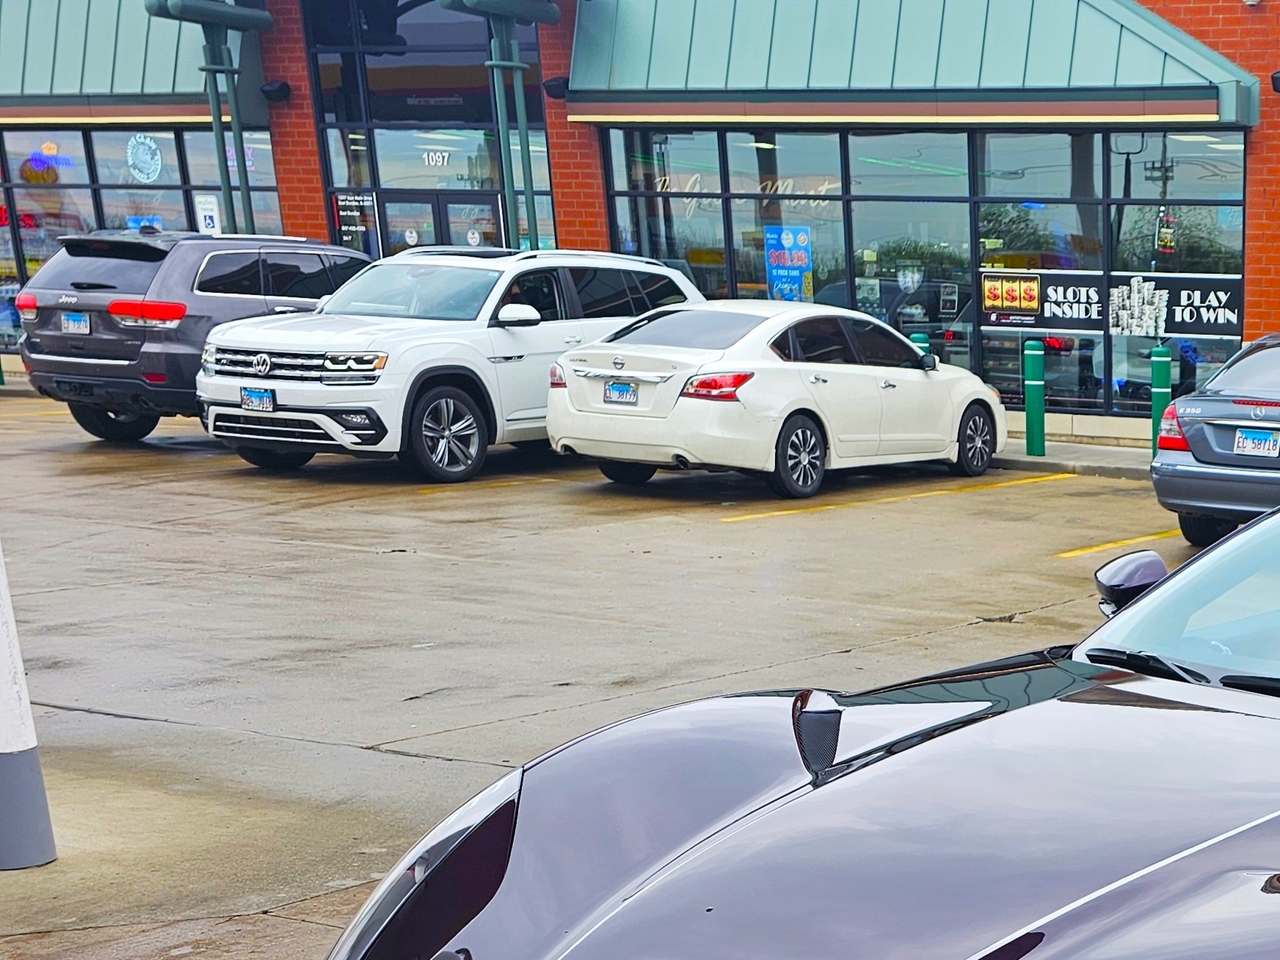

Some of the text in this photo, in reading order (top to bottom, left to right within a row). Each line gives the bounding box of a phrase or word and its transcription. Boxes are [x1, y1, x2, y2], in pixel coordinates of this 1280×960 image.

[422, 152, 451, 167] 1097
[59, 294, 78, 305] Jeep
[1046, 285, 1099, 303] SLOTS
[1180, 289, 1232, 307] PLAY
[1043, 302, 1103, 319] INSIDE
[1171, 306, 1238, 325] TO WIN
[1237, 436, 1277, 452] EC 58718
